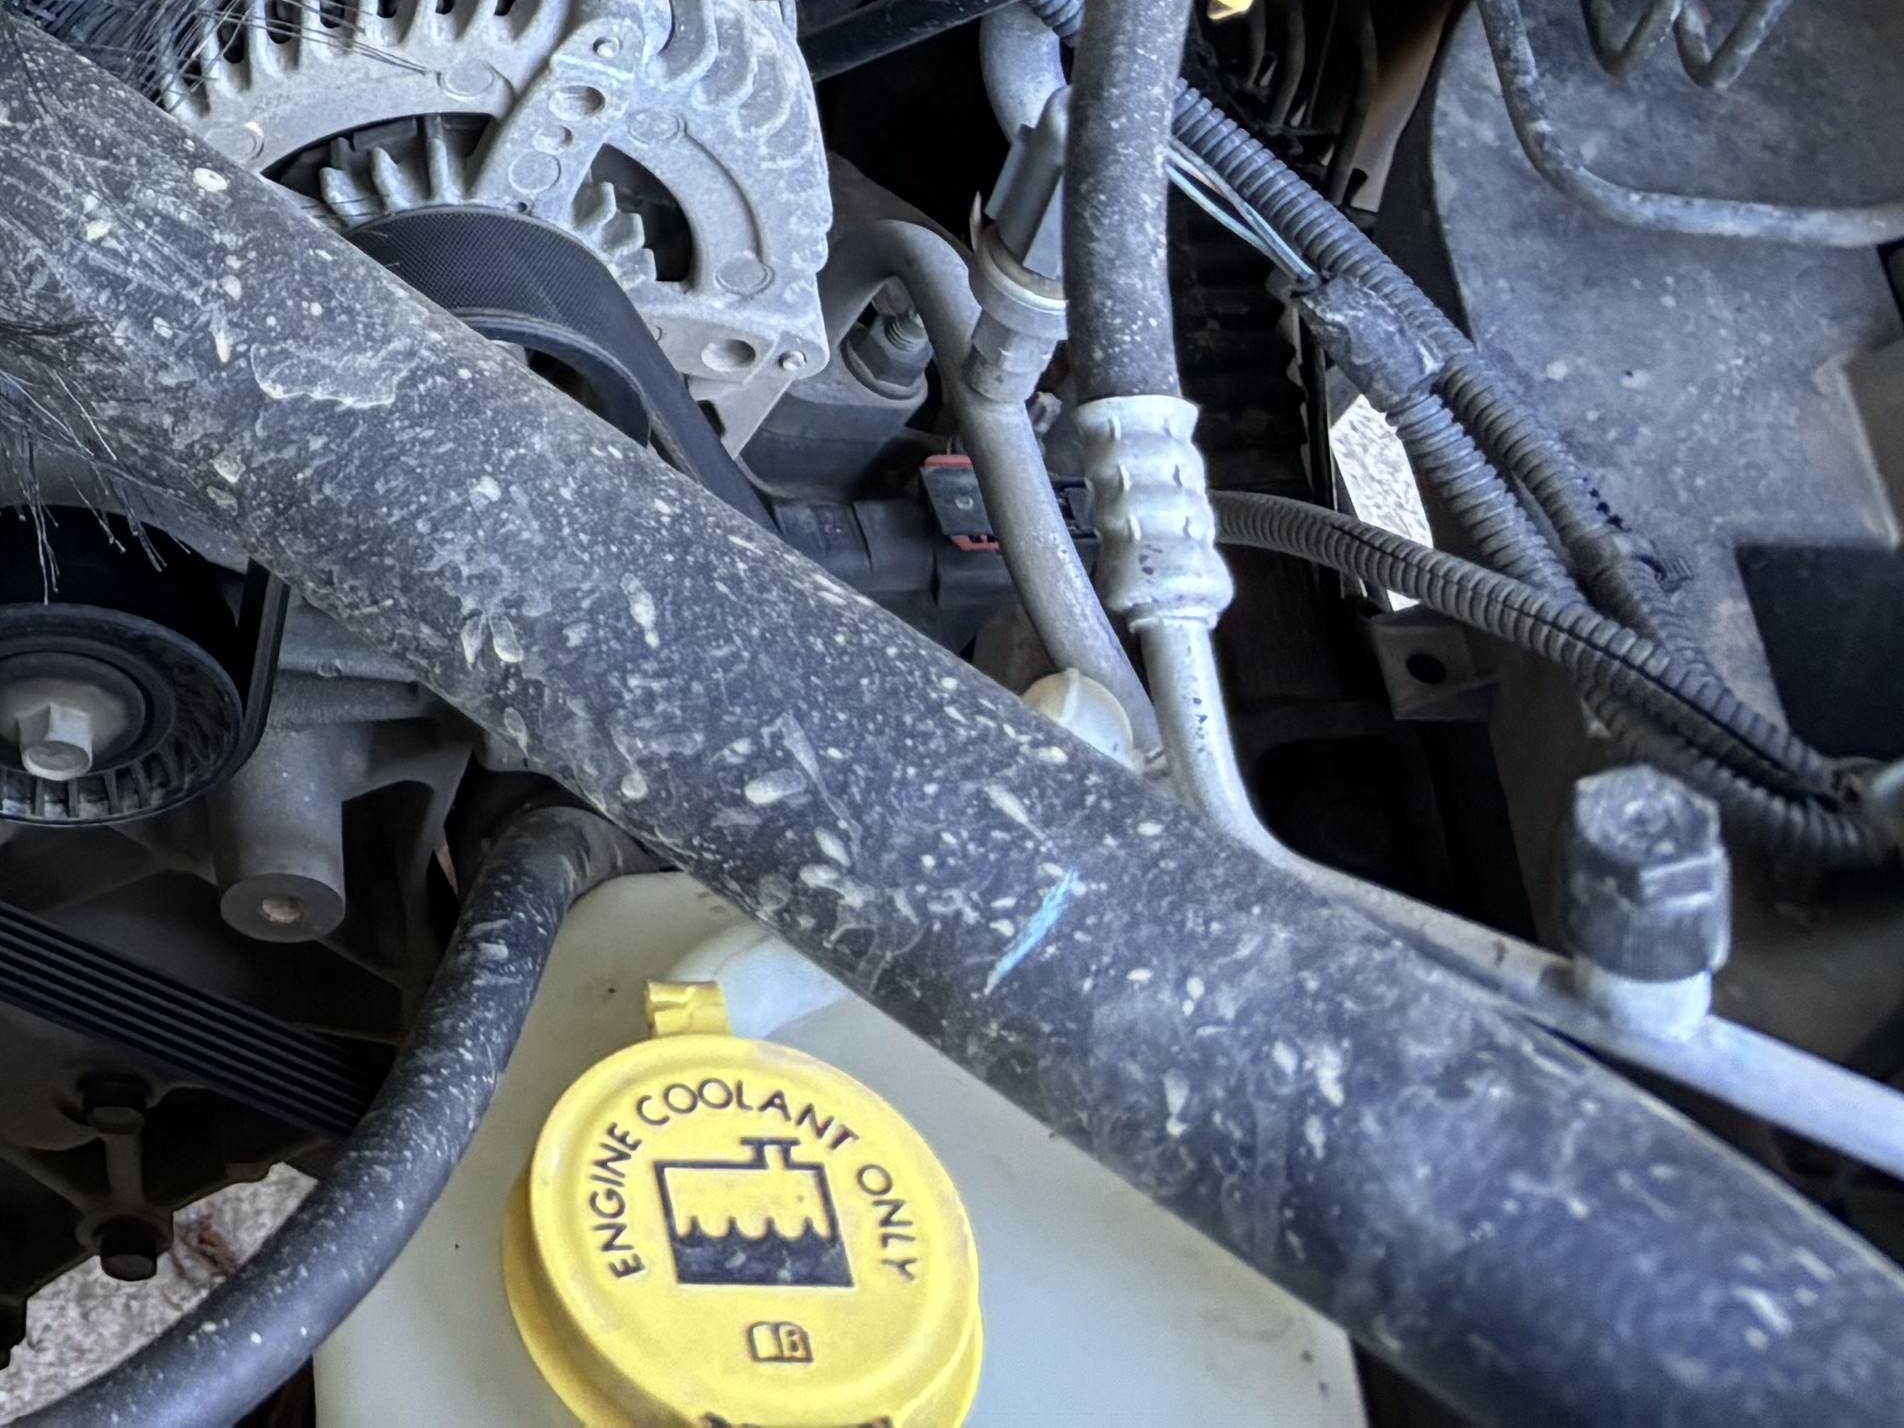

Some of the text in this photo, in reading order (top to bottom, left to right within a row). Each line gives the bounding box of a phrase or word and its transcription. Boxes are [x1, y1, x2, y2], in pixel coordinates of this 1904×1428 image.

[588, 1077, 918, 1282] ENGINE COOLANT ONLY
